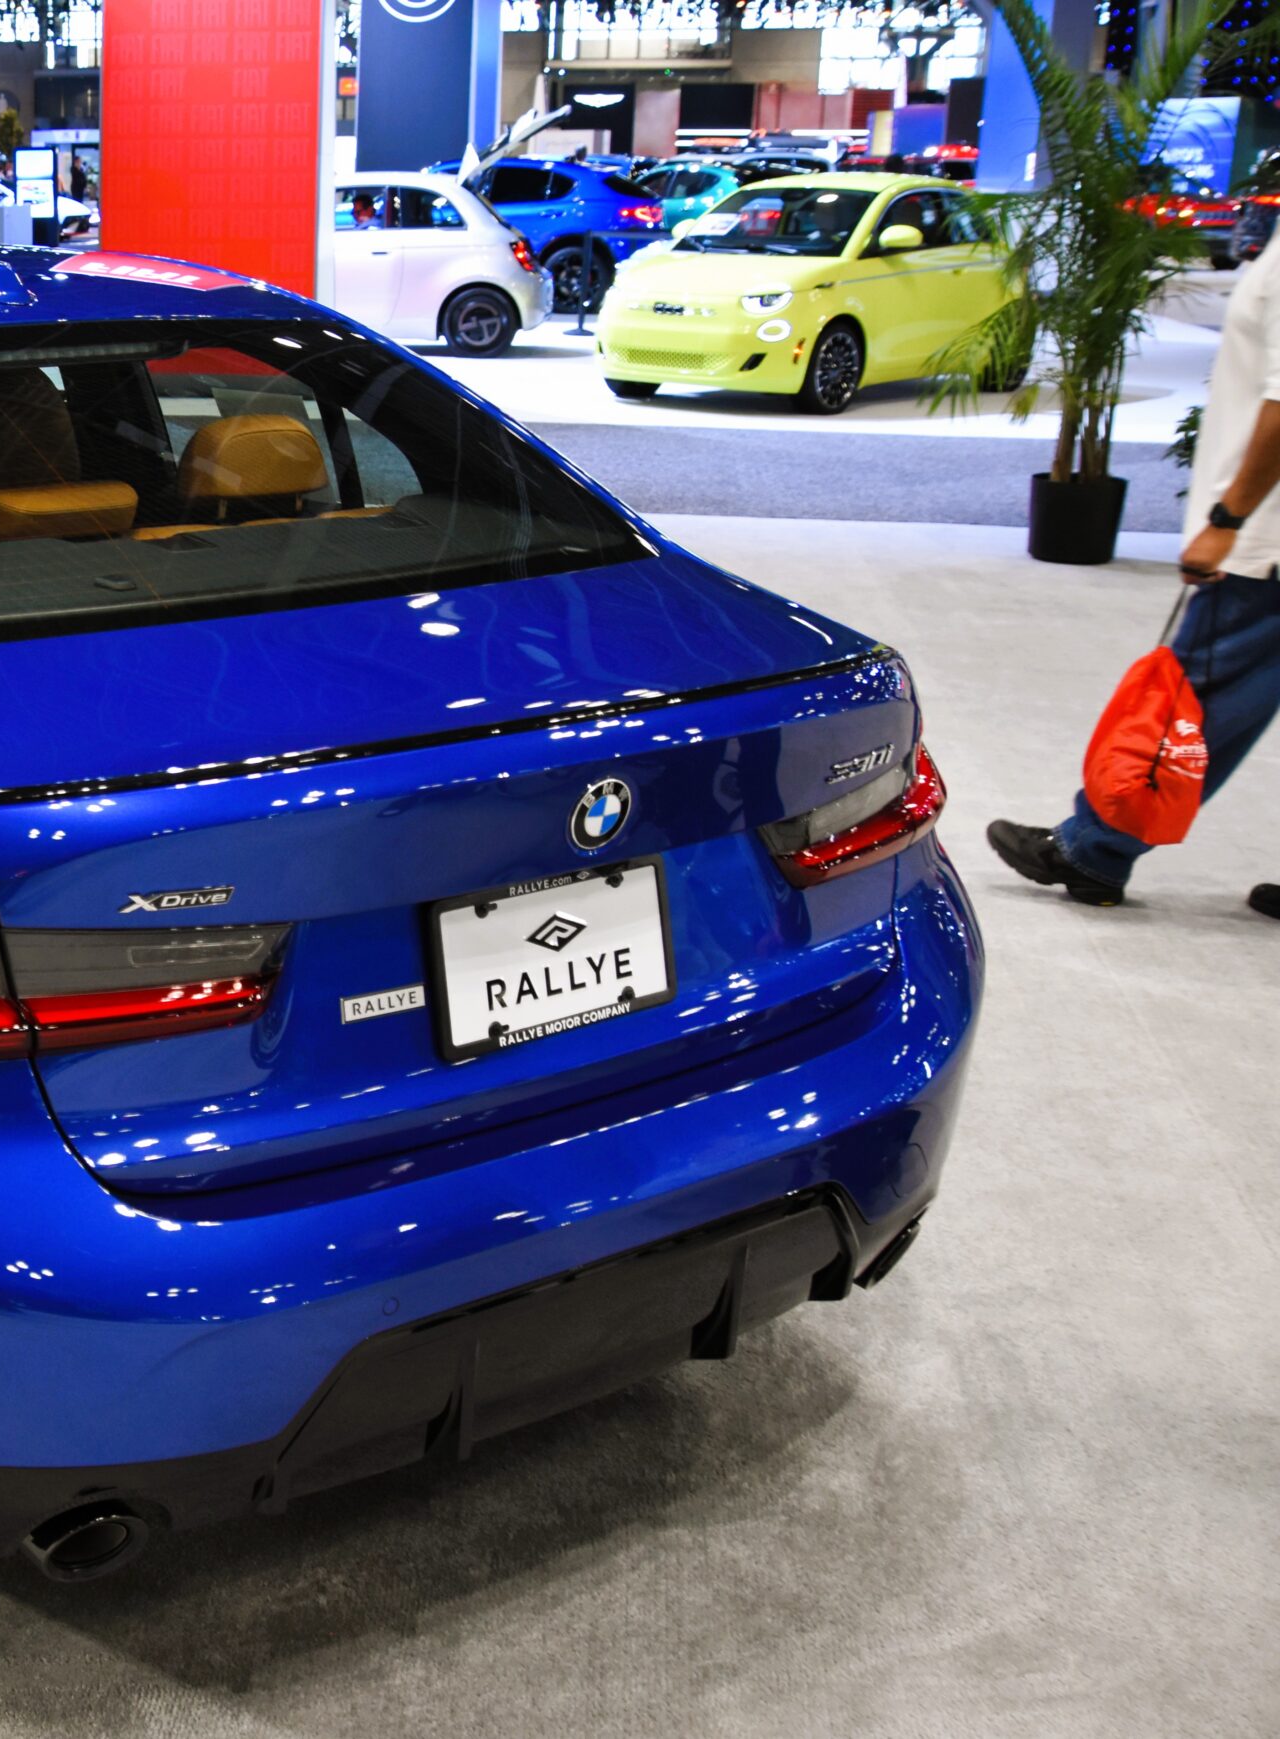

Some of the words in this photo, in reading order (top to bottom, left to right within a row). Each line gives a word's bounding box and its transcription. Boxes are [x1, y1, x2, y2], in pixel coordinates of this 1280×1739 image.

[509, 875, 572, 897] RALLYE.com
[485, 947, 633, 1011] RALLYE
[352, 990, 417, 1016] RALLYE
[499, 1026, 543, 1047] RALLYE
[545, 1015, 581, 1035] MOTOR
[582, 1002, 631, 1024] COMPANY
